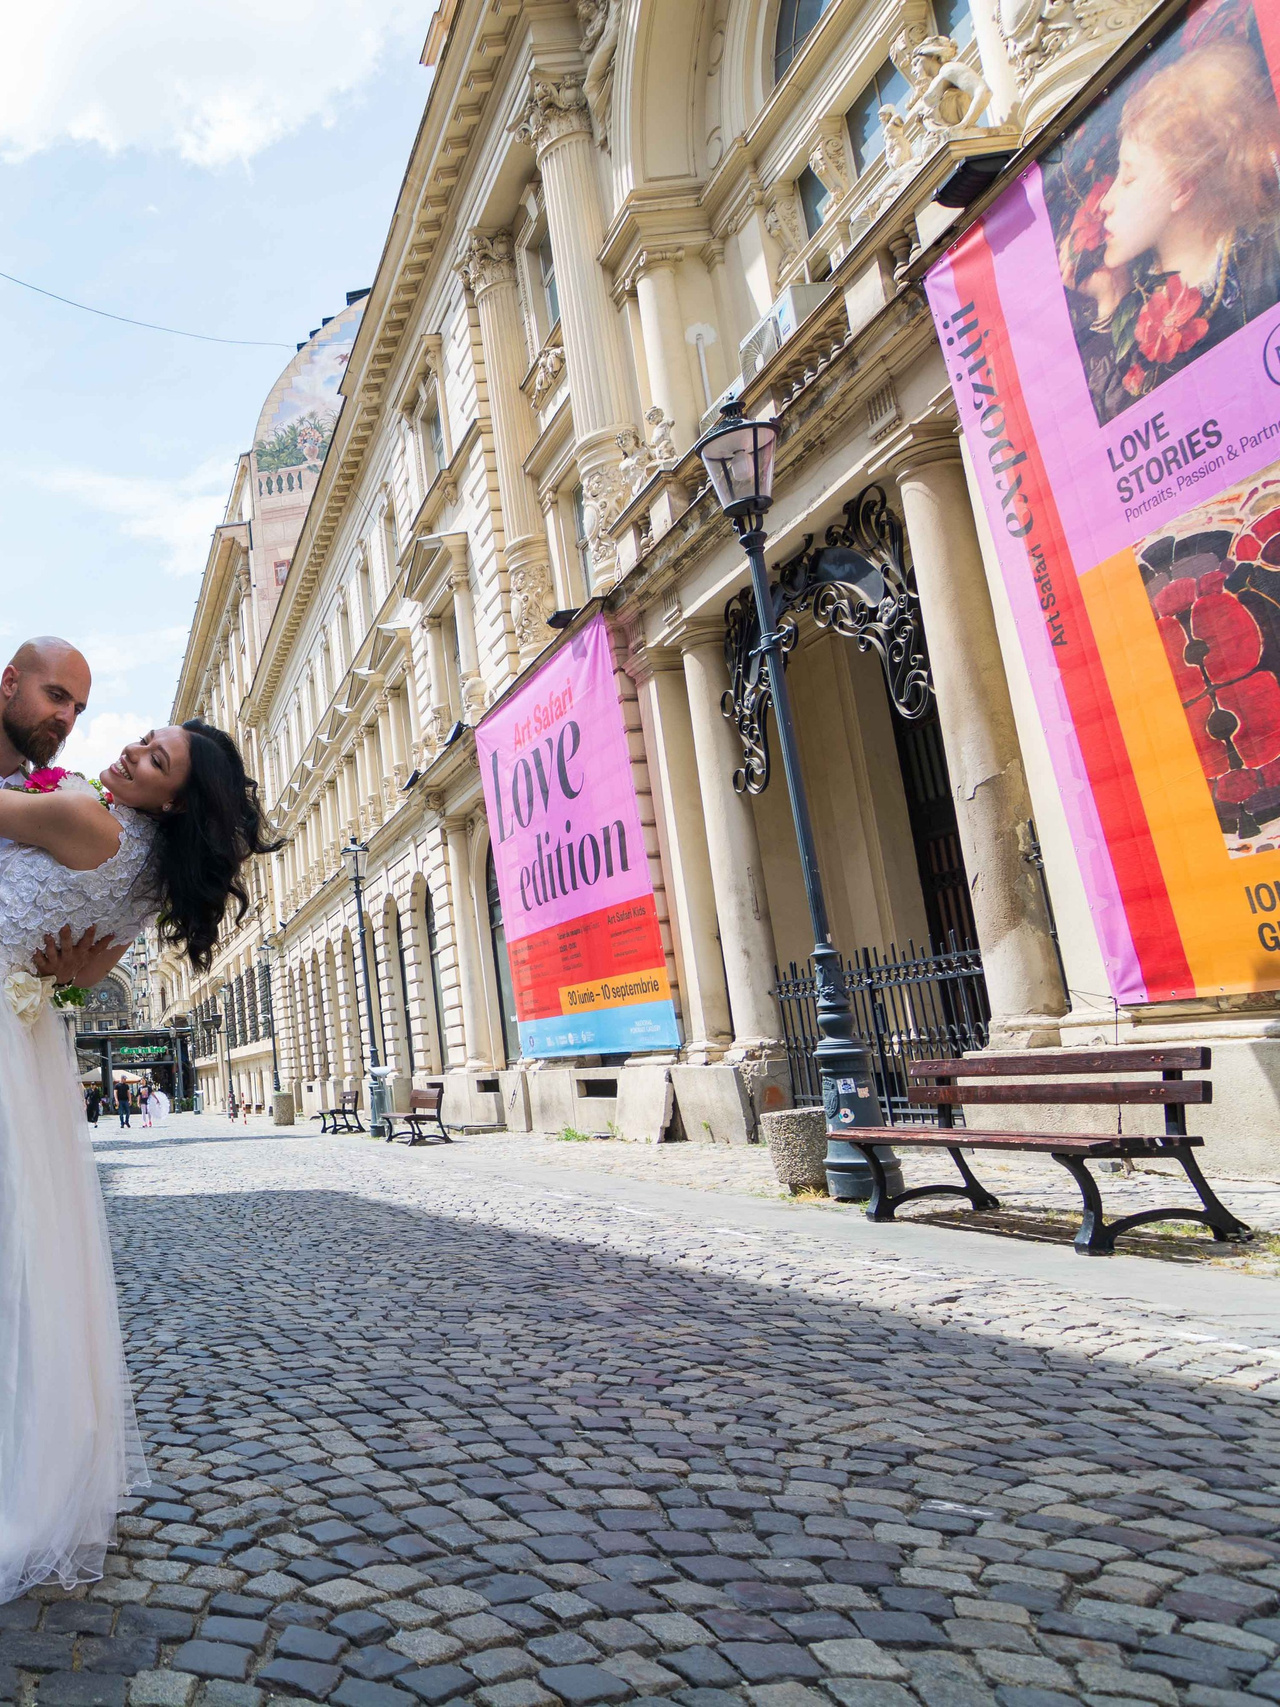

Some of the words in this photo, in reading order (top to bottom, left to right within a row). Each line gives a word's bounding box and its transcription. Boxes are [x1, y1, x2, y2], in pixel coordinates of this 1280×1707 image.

[1107, 411, 1170, 473] LOVE
[1116, 419, 1223, 503] STORIES
[1124, 486, 1177, 523] Portraits,
[1176, 455, 1226, 491] Passion
[1226, 444, 1240, 461] &
[1239, 419, 1280, 453] Partn
[1027, 543, 1057, 610] Safari
[1047, 610, 1068, 647] Art
[514, 715, 533, 752] Art
[533, 677, 574, 736] Safari
[490, 720, 584, 845] Love
[520, 819, 631, 911] edition
[607, 914, 617, 925] Art
[616, 909, 633, 922] Safari
[633, 906, 647, 917] Kids
[1257, 921, 1280, 952] G
[567, 990, 578, 1006] 30
[577, 988, 595, 1005] iunie
[601, 984, 611, 1000] 10
[611, 976, 660, 1001] septembrie
